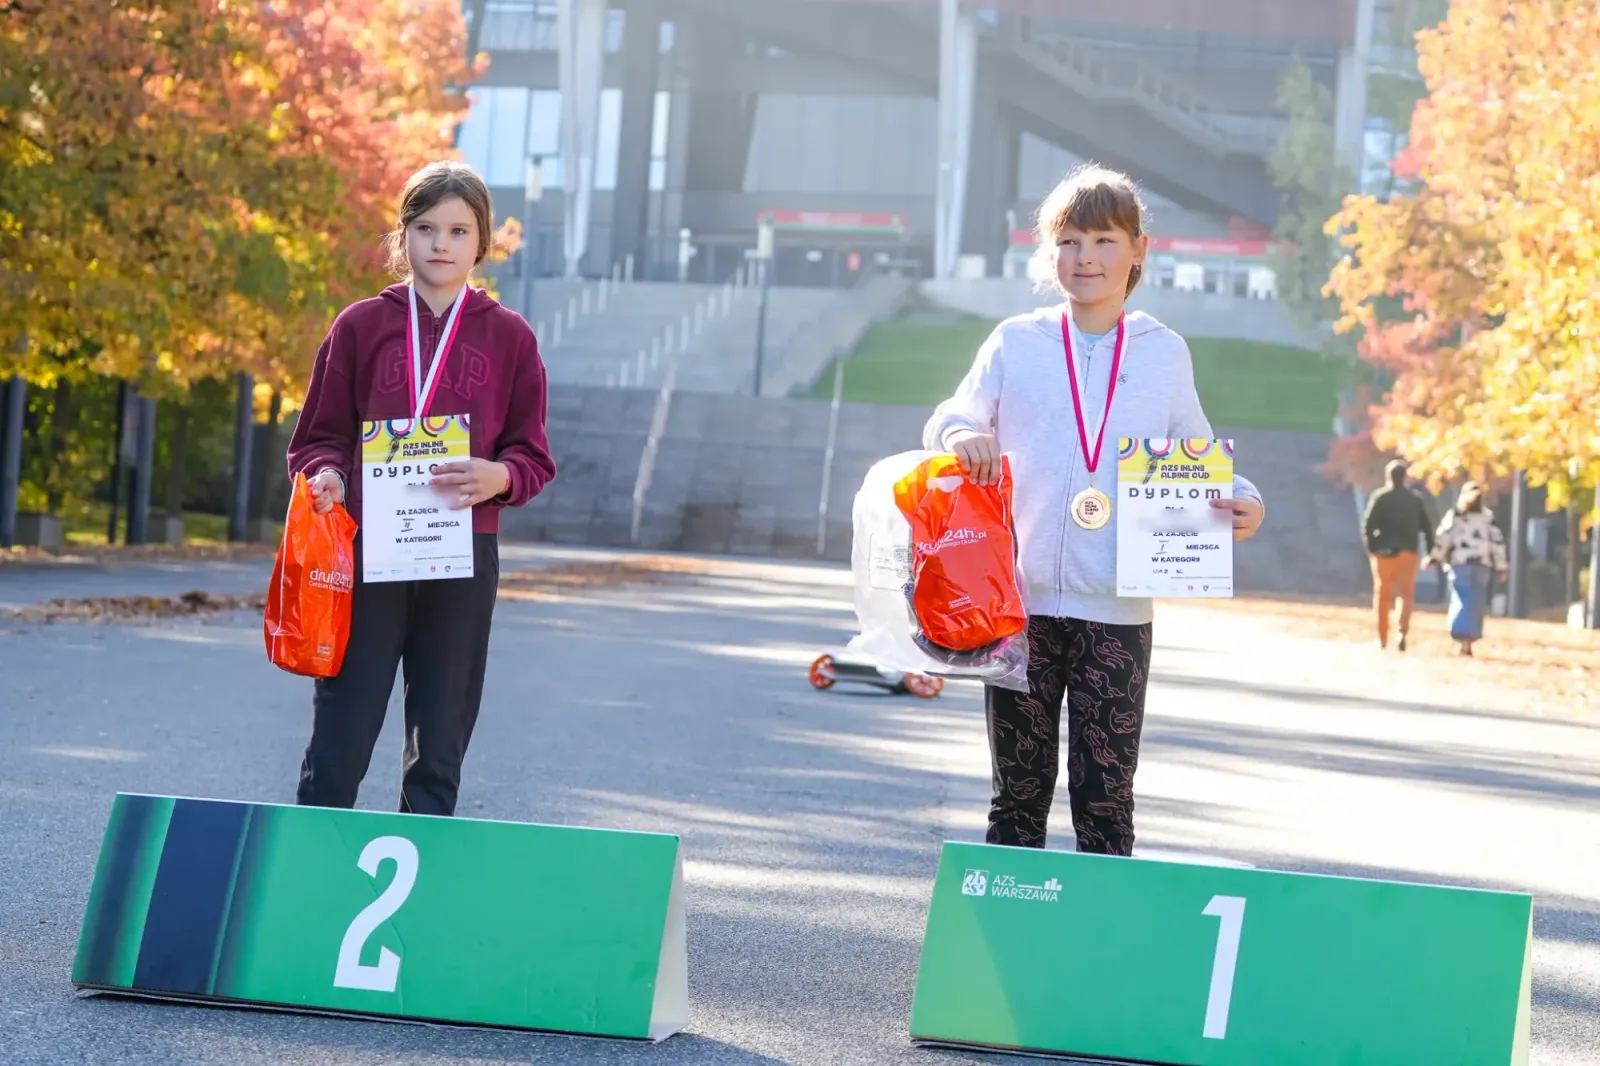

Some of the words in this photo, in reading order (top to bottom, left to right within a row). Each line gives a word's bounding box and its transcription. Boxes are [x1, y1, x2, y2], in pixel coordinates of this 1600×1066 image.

[403, 442, 420, 450] AZS
[421, 440, 444, 448] INLINE
[403, 448, 430, 457] ALPINE
[1180, 464, 1205, 472] INLINE
[1161, 472, 1190, 480] ALPINE
[1191, 472, 1210, 480] CUP
[1128, 487, 1221, 500] DYPLOM
[427, 521, 460, 529] MIEJSCA
[404, 535, 442, 544] KATEGORII
[992, 875, 1016, 887] AZS
[991, 885, 1059, 902] WARSZAWA
[333, 835, 419, 992] 2
[1201, 895, 1247, 1039] 1
